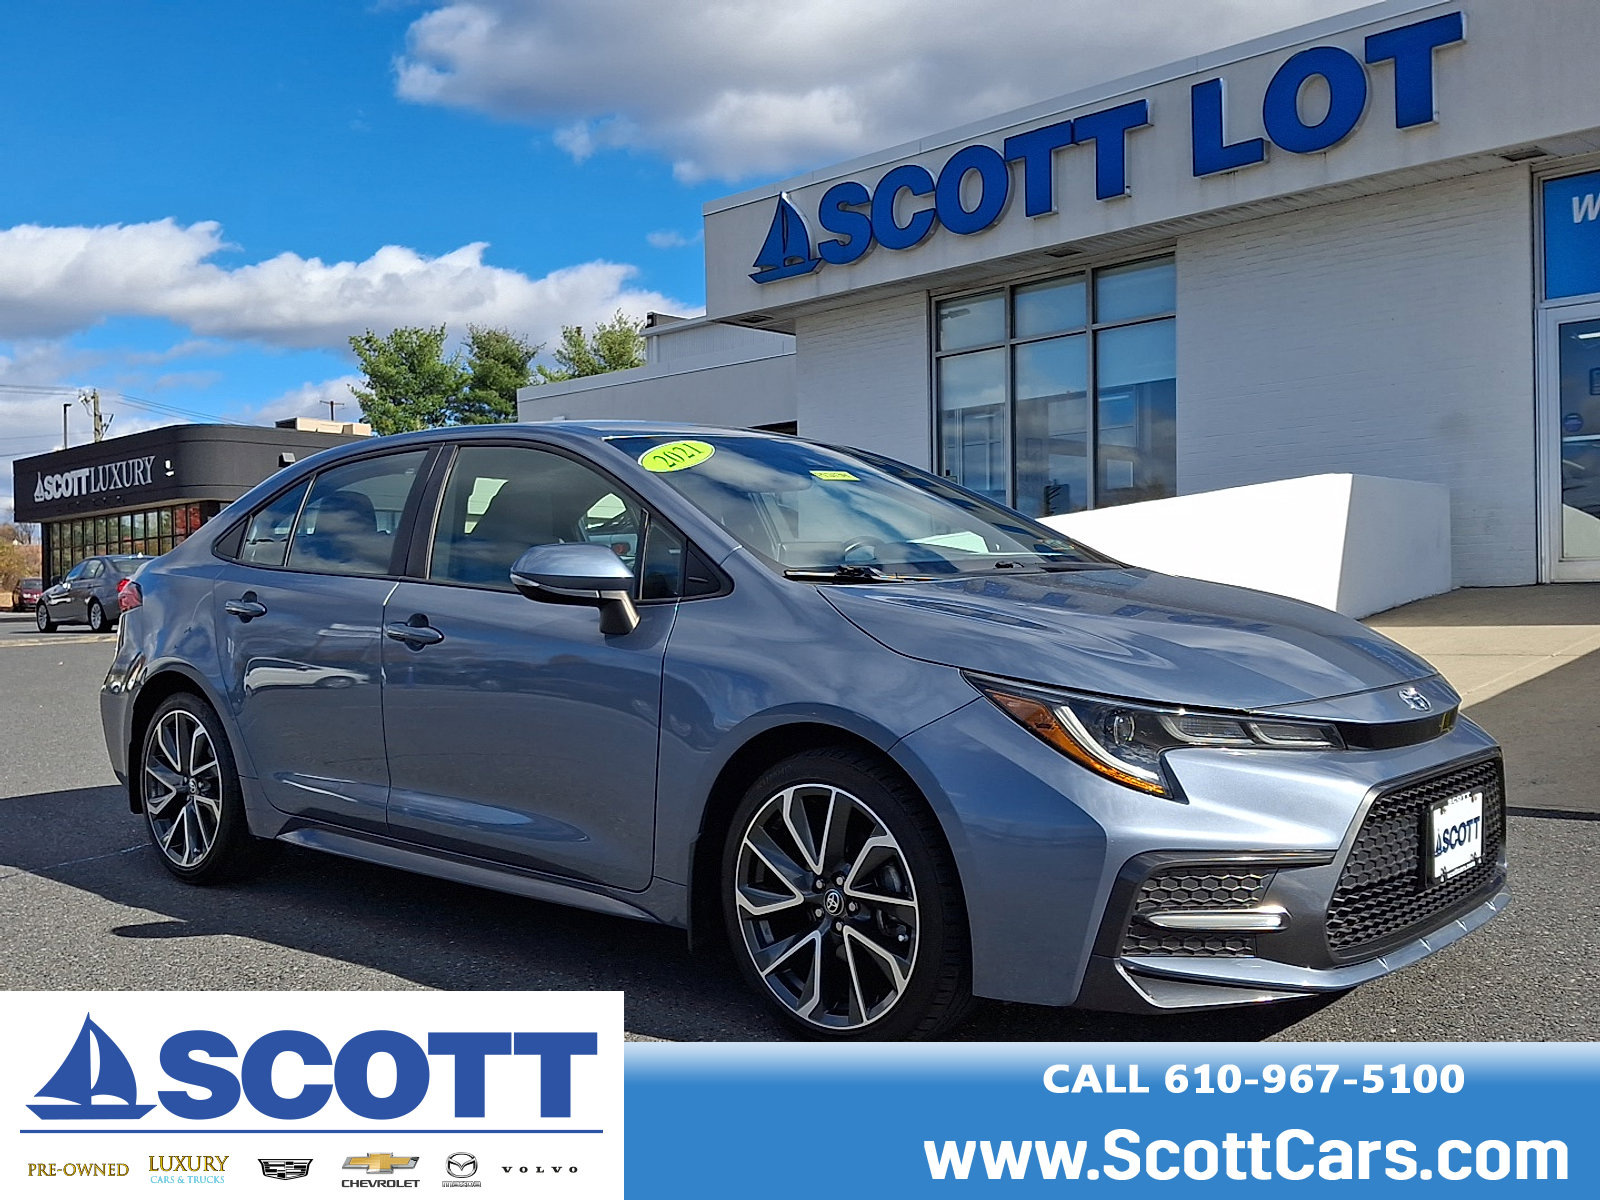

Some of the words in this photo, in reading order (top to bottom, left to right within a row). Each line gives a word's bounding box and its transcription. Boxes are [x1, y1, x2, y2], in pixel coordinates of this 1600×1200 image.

[817, 99, 1150, 266] SCOTT
[1191, 11, 1465, 175] LOT
[653, 443, 702, 468] 2021
[1443, 816, 1480, 853] SCOTT
